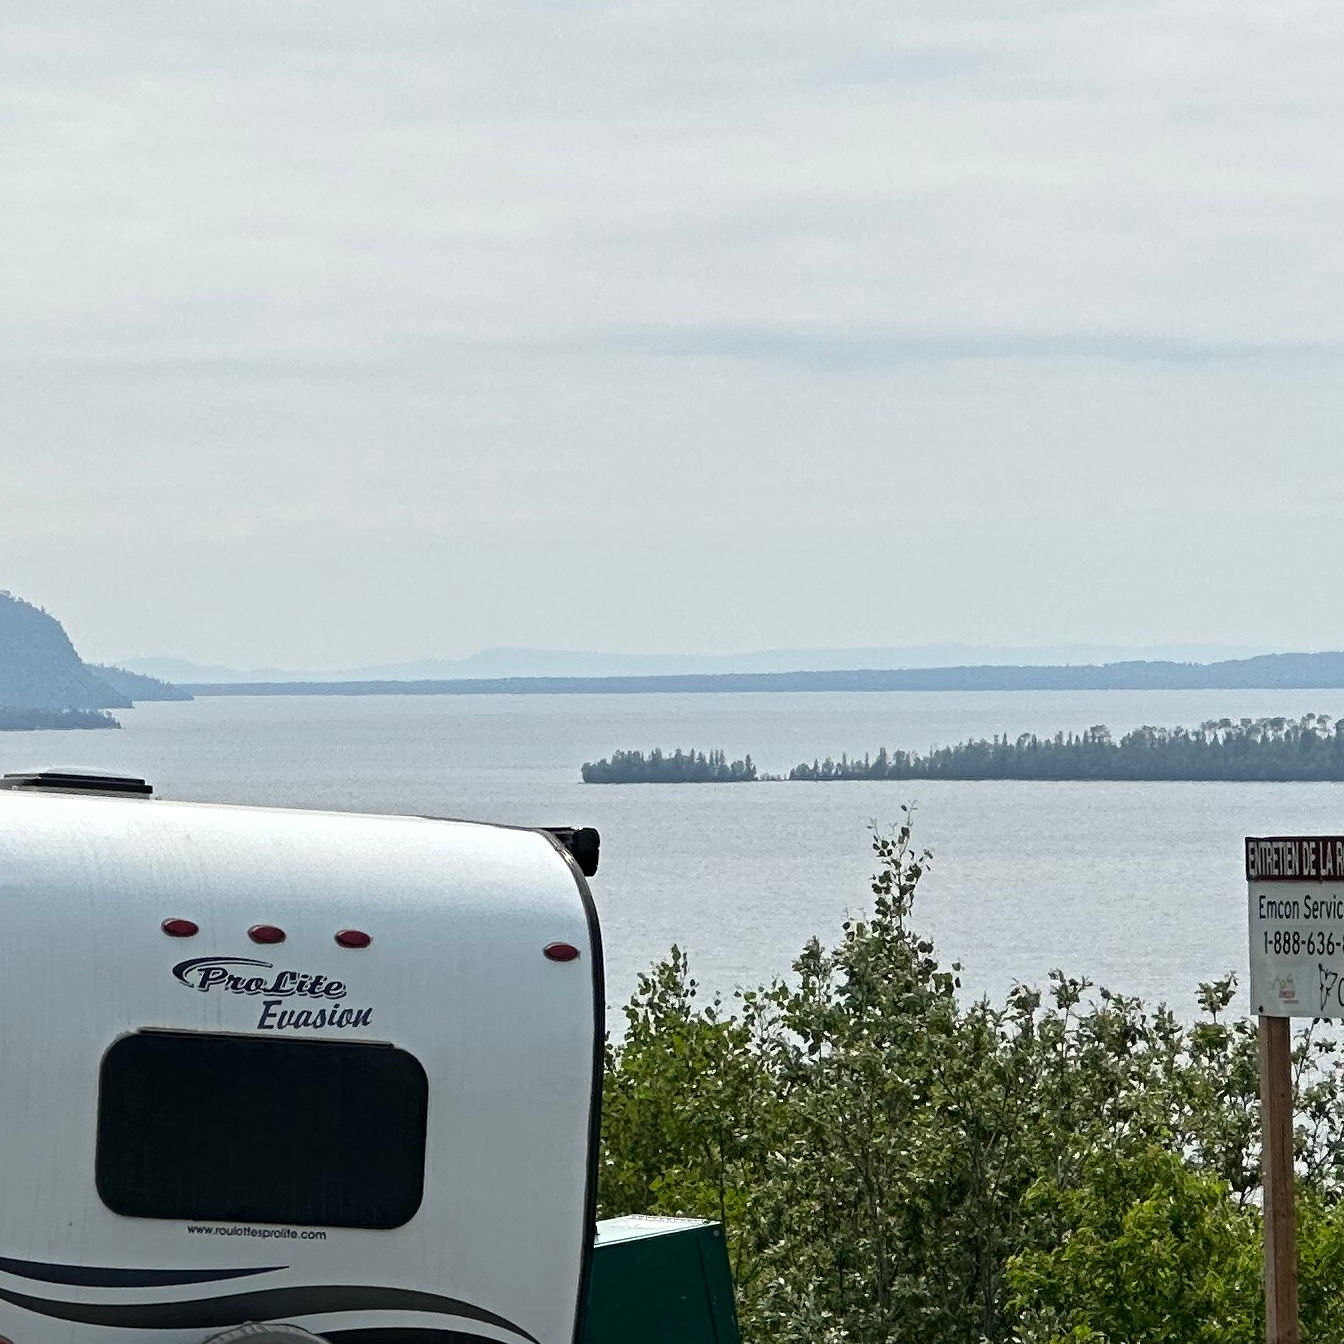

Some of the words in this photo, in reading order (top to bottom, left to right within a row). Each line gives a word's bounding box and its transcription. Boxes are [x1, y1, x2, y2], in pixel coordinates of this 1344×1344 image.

[1248, 841, 1299, 876] ENTRETIEN
[1302, 841, 1316, 876] DE
[1319, 841, 1334, 876] LA
[1259, 895, 1299, 919] Emcon
[196, 966, 347, 999] ProLite
[257, 1000, 373, 1030] Evasion
[187, 1225, 327, 1240] www.roulottesprolite.com
